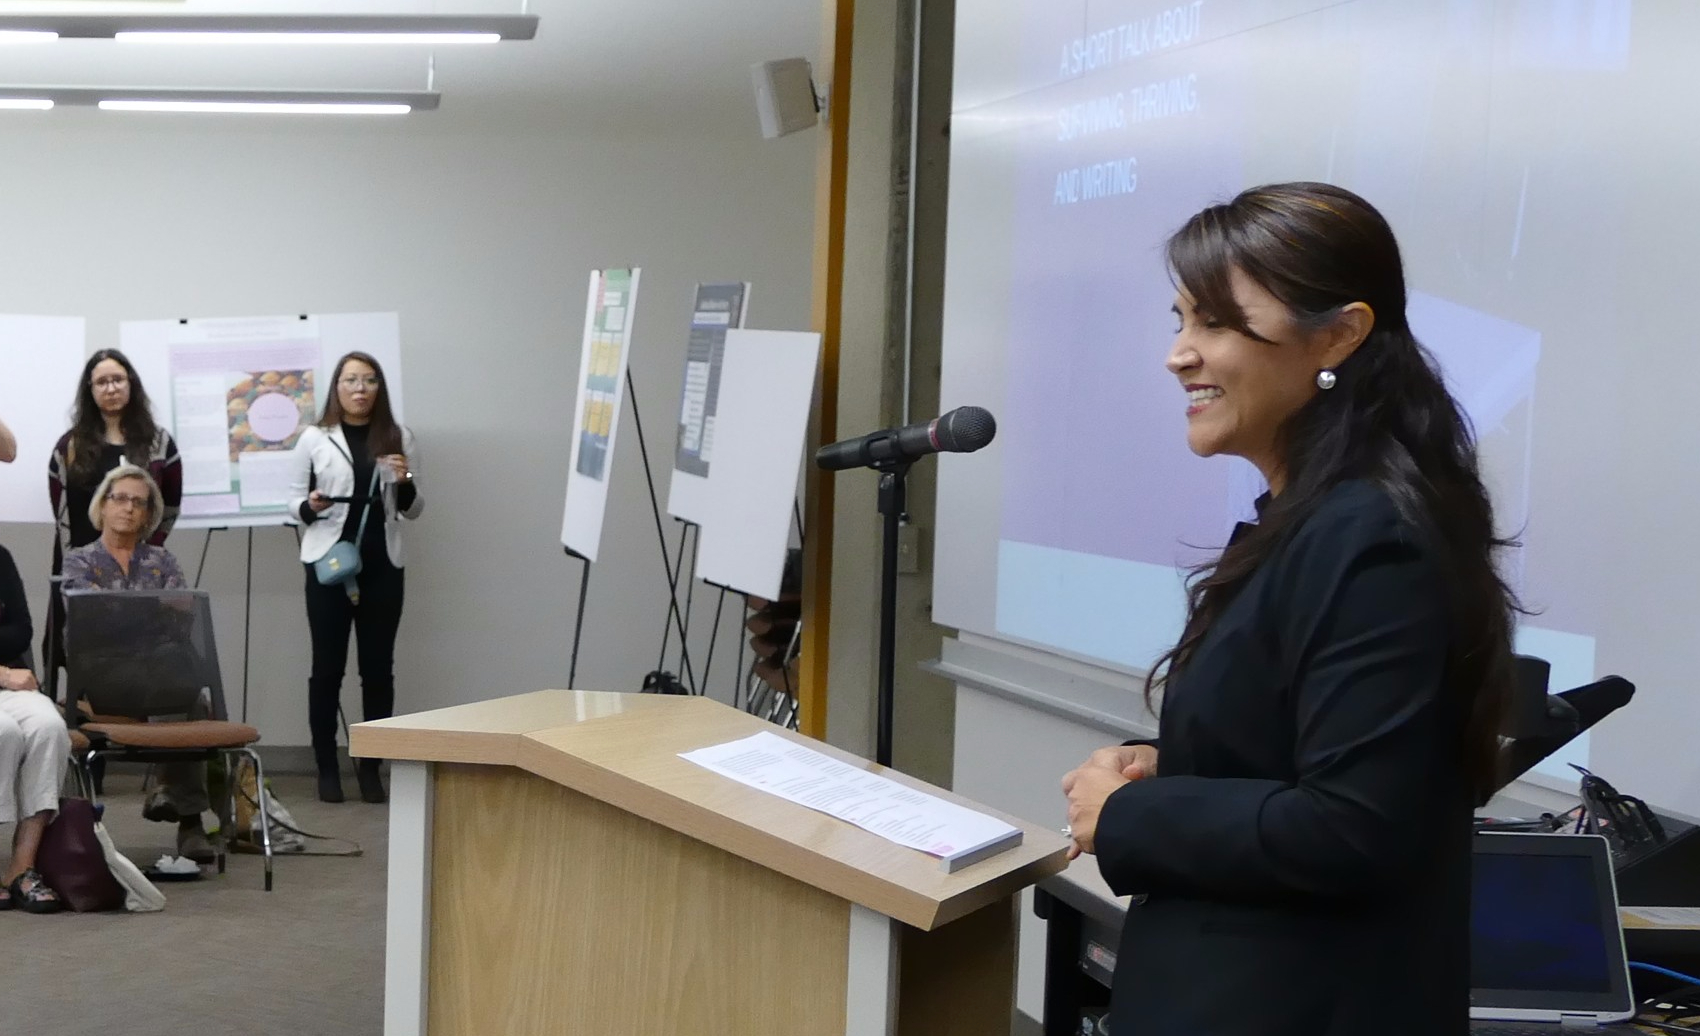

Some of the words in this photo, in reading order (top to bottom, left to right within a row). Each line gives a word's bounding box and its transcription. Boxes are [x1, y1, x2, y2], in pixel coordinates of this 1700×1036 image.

[1059, 44, 1070, 77] A
[1071, 28, 1116, 74] SHORT
[1117, 17, 1151, 59] TALK
[1152, 1, 1204, 49] ABOUT
[1054, 168, 1080, 205] AND
[1080, 156, 1138, 201] WRITING
